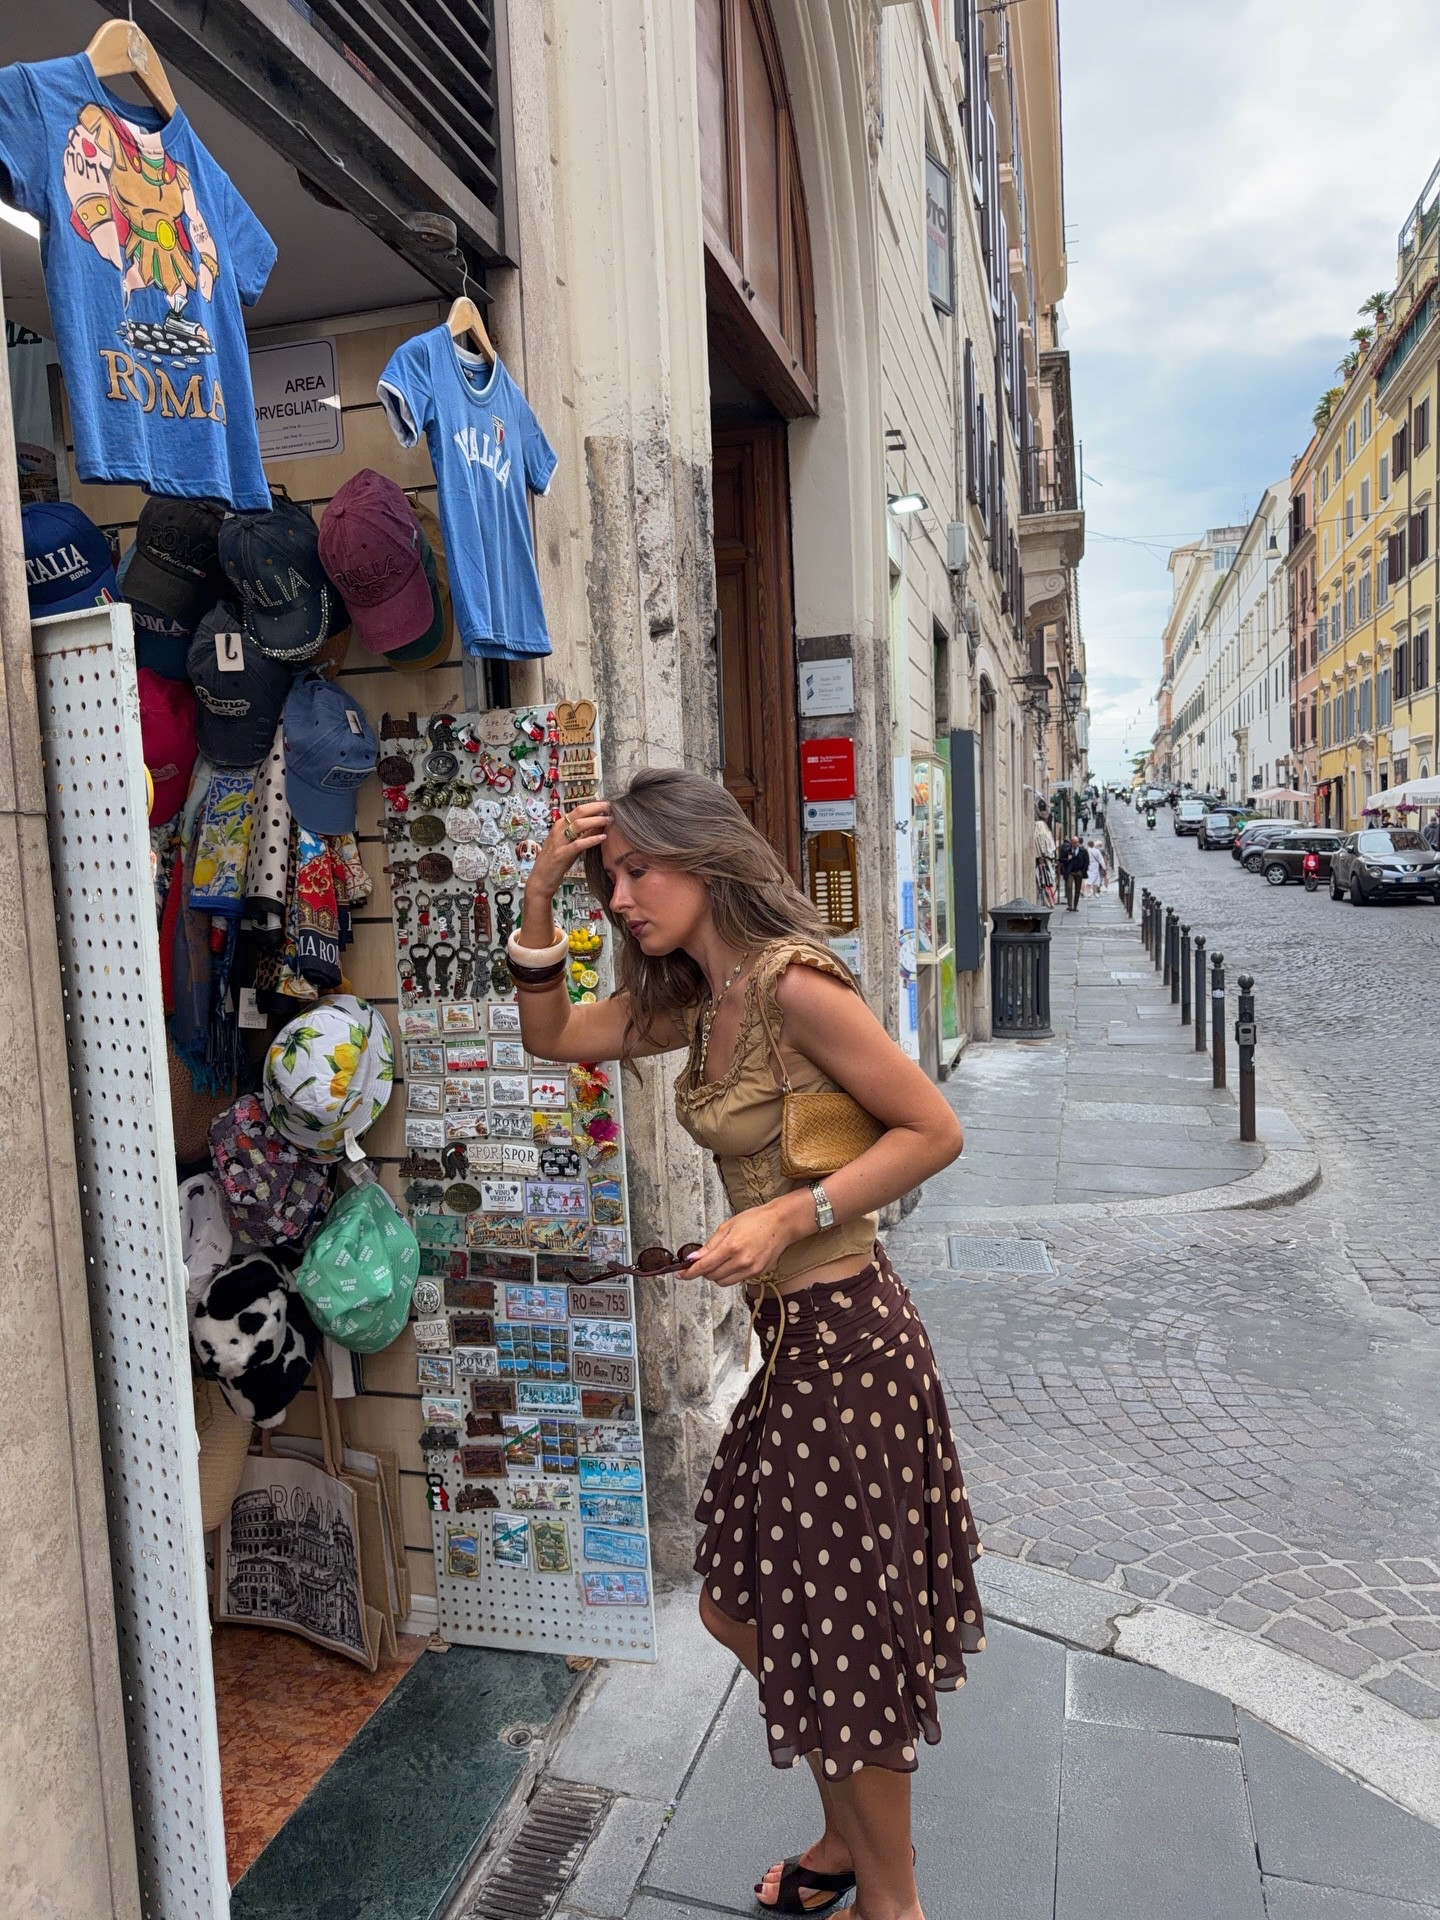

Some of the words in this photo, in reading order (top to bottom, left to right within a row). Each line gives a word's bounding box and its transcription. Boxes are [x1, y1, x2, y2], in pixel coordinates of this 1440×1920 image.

[284, 375, 326, 395] AREA
[69, 567, 92, 582] ROMA
[495, 1118, 527, 1129] ROMA
[489, 1194, 515, 1202] VERITAS
[373, 1265, 386, 1276] CIAO
[375, 1268, 391, 1281] BELLA
[572, 1293, 587, 1310] RO
[605, 1293, 625, 1312] 753
[579, 1328, 625, 1344] ROMA
[460, 1357, 491, 1367] ROMA
[577, 1360, 591, 1378] RO
[610, 1364, 630, 1383] 753
[587, 1461, 632, 1473] ROMA
[270, 1484, 334, 1532] ROMA
